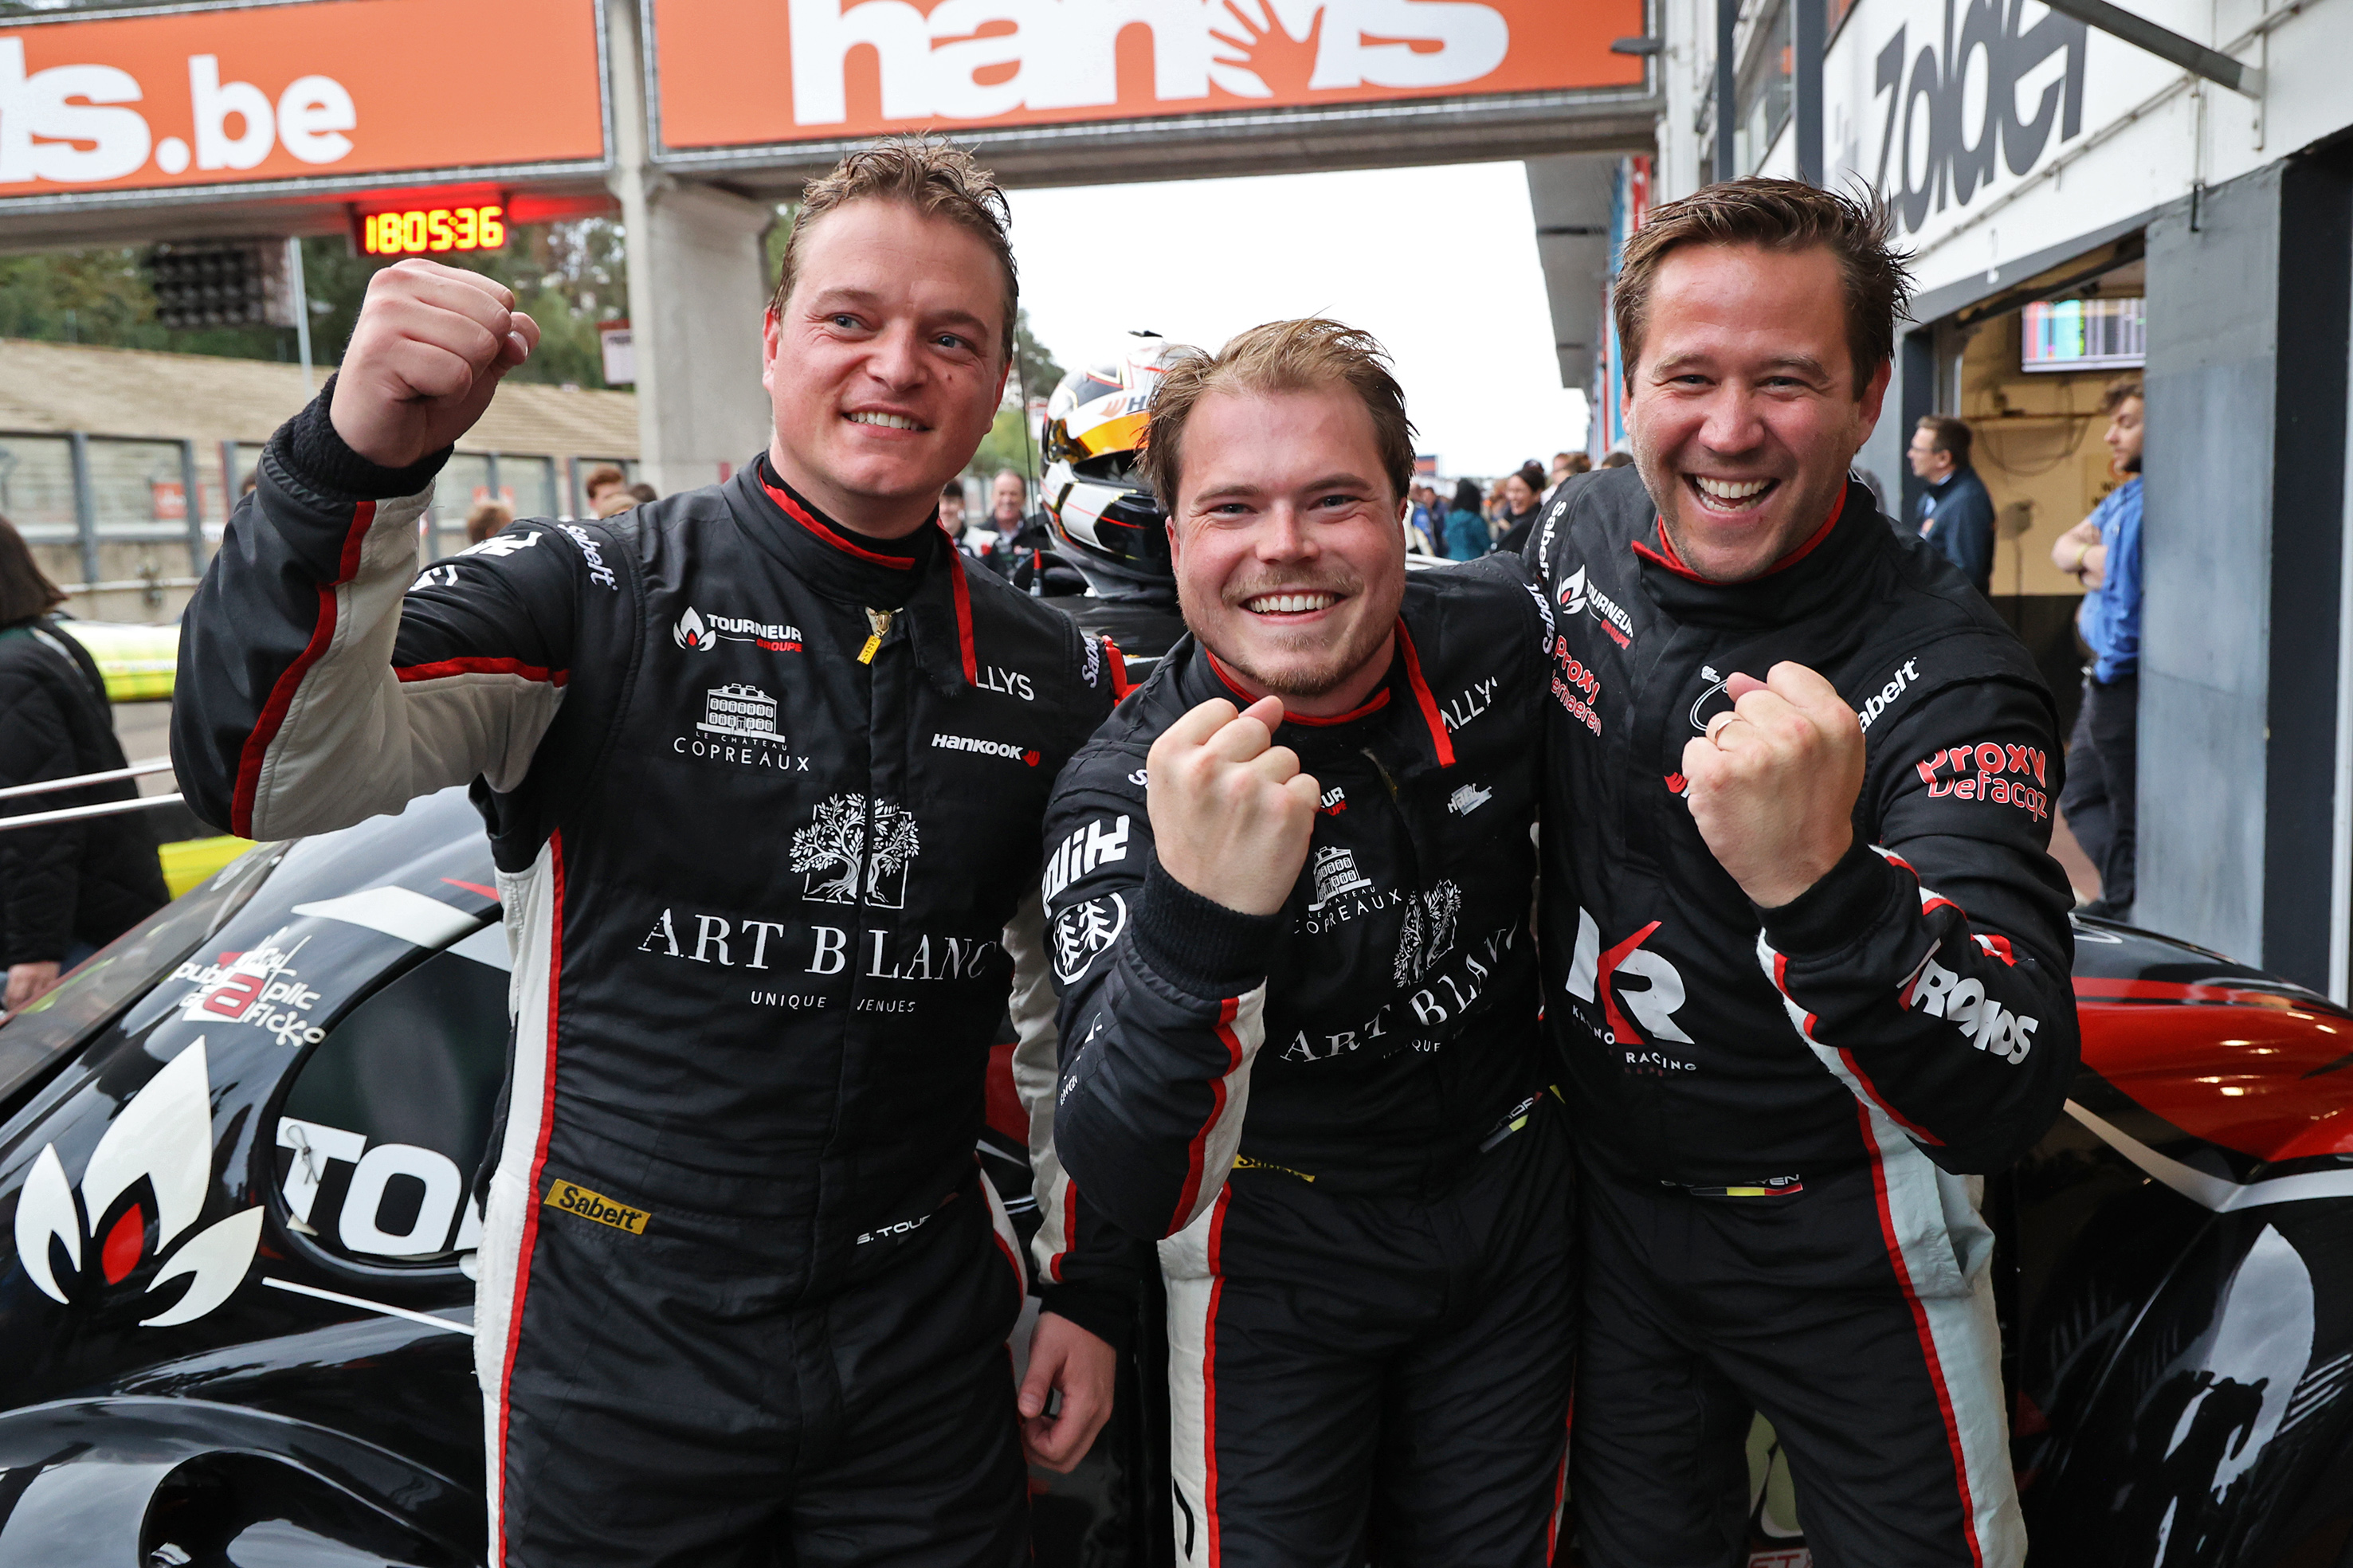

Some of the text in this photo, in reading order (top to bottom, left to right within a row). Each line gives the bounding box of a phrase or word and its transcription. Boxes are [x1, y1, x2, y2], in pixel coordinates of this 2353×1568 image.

[0, 37, 357, 184] s.be
[706, 613, 803, 643] TOURNEUR
[756, 638, 803, 653] GROUPE
[1550, 676, 1602, 738] erhaeren
[673, 737, 810, 772] COPREAUX
[1294, 888, 1402, 935] OPREAUX
[637, 907, 785, 970] ART
[751, 990, 827, 1010] UNIQUE
[1280, 1004, 1391, 1063] ART
[1625, 1051, 1697, 1072] RACING
[559, 1185, 642, 1229] Sabelt
